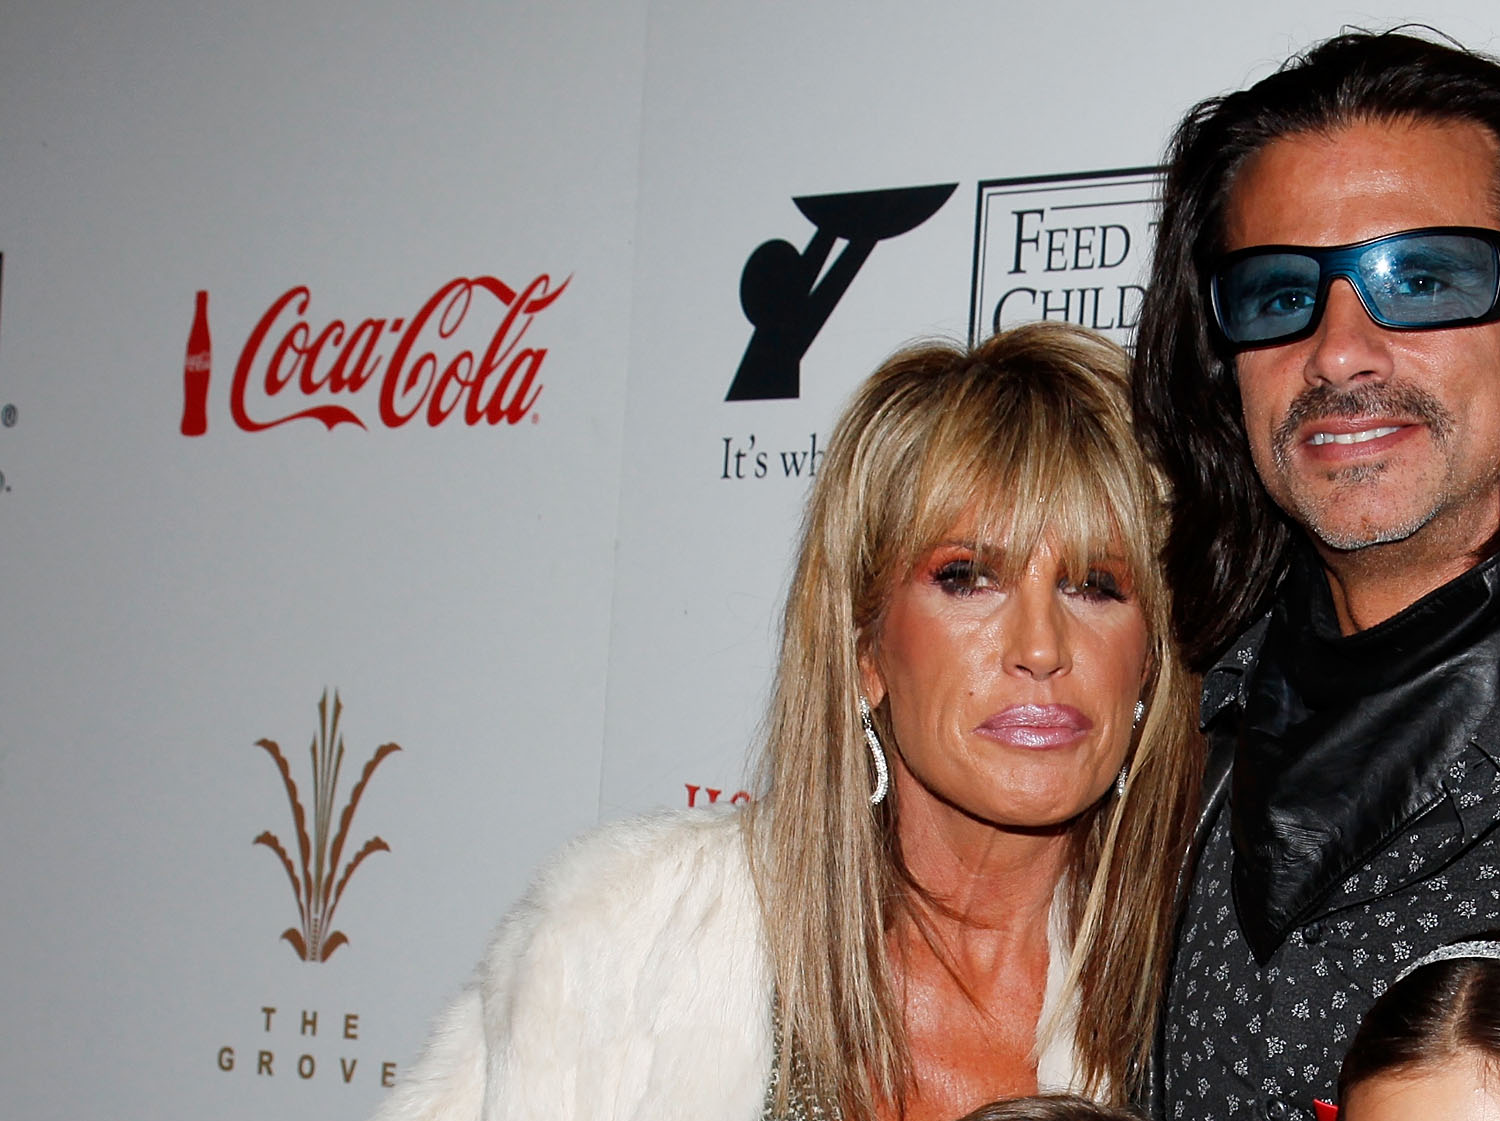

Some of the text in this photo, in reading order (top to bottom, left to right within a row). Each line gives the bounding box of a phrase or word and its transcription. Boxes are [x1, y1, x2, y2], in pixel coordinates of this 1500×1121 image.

[1008, 209, 1131, 275] FEED
[229, 271, 574, 433] Coca-Cola
[721, 433, 768, 479] It's
[262, 1007, 359, 1040] THE
[218, 1046, 397, 1088] GROVE
